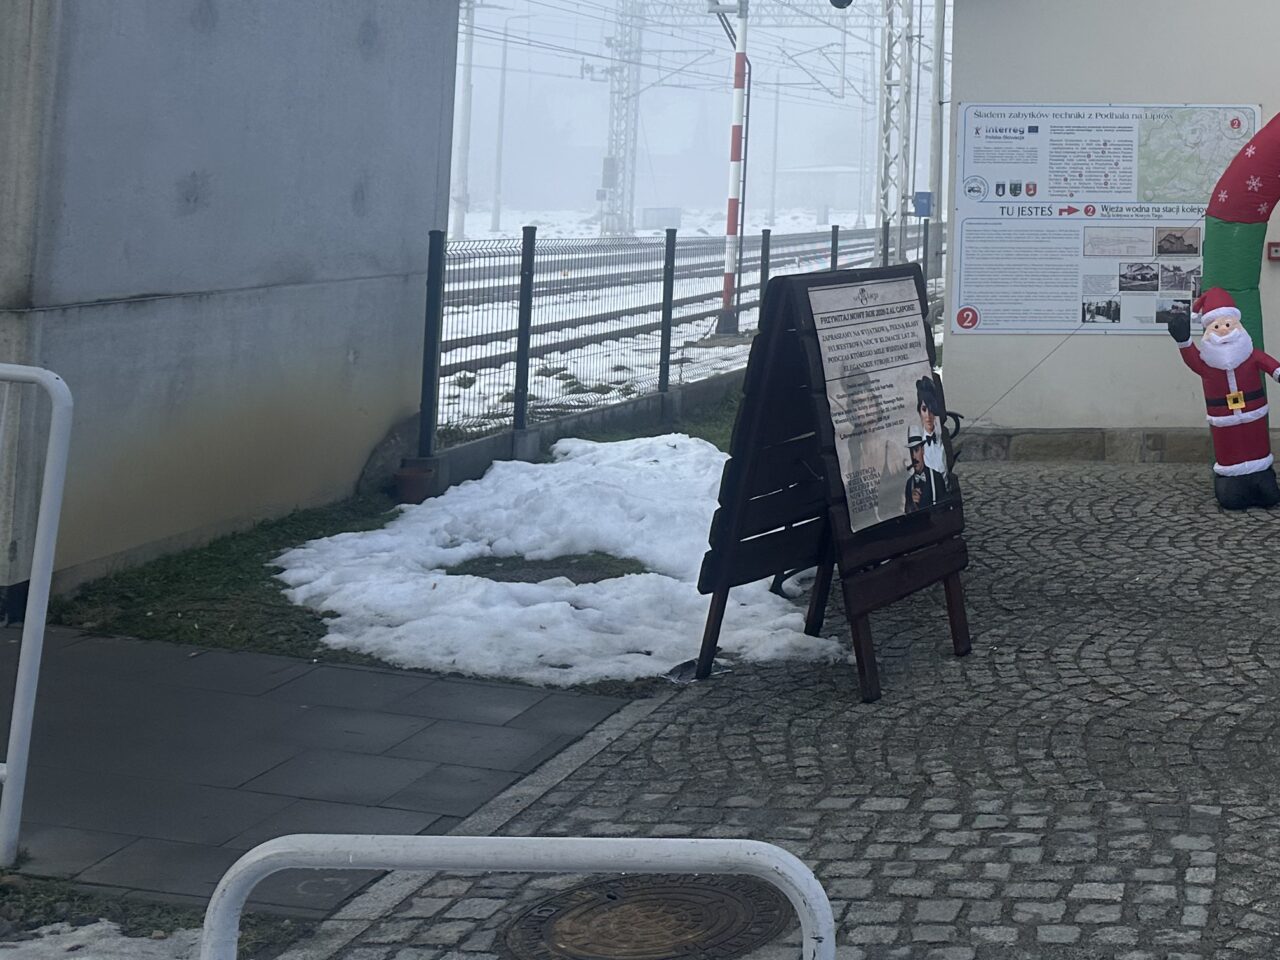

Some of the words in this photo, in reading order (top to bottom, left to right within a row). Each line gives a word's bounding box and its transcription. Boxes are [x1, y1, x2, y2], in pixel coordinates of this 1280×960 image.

[973, 109, 1006, 119] Śladem
[1008, 111, 1049, 120] zabytków
[1052, 111, 1085, 120] techniki
[1095, 112, 1130, 120] Podhala
[1000, 206, 1014, 216] TU
[1017, 205, 1053, 217] JESTEŚ
[1100, 205, 1123, 213] Wieża
[1125, 205, 1149, 213] wodna
[1162, 204, 1180, 215] stacji
[963, 312, 973, 326] 2
